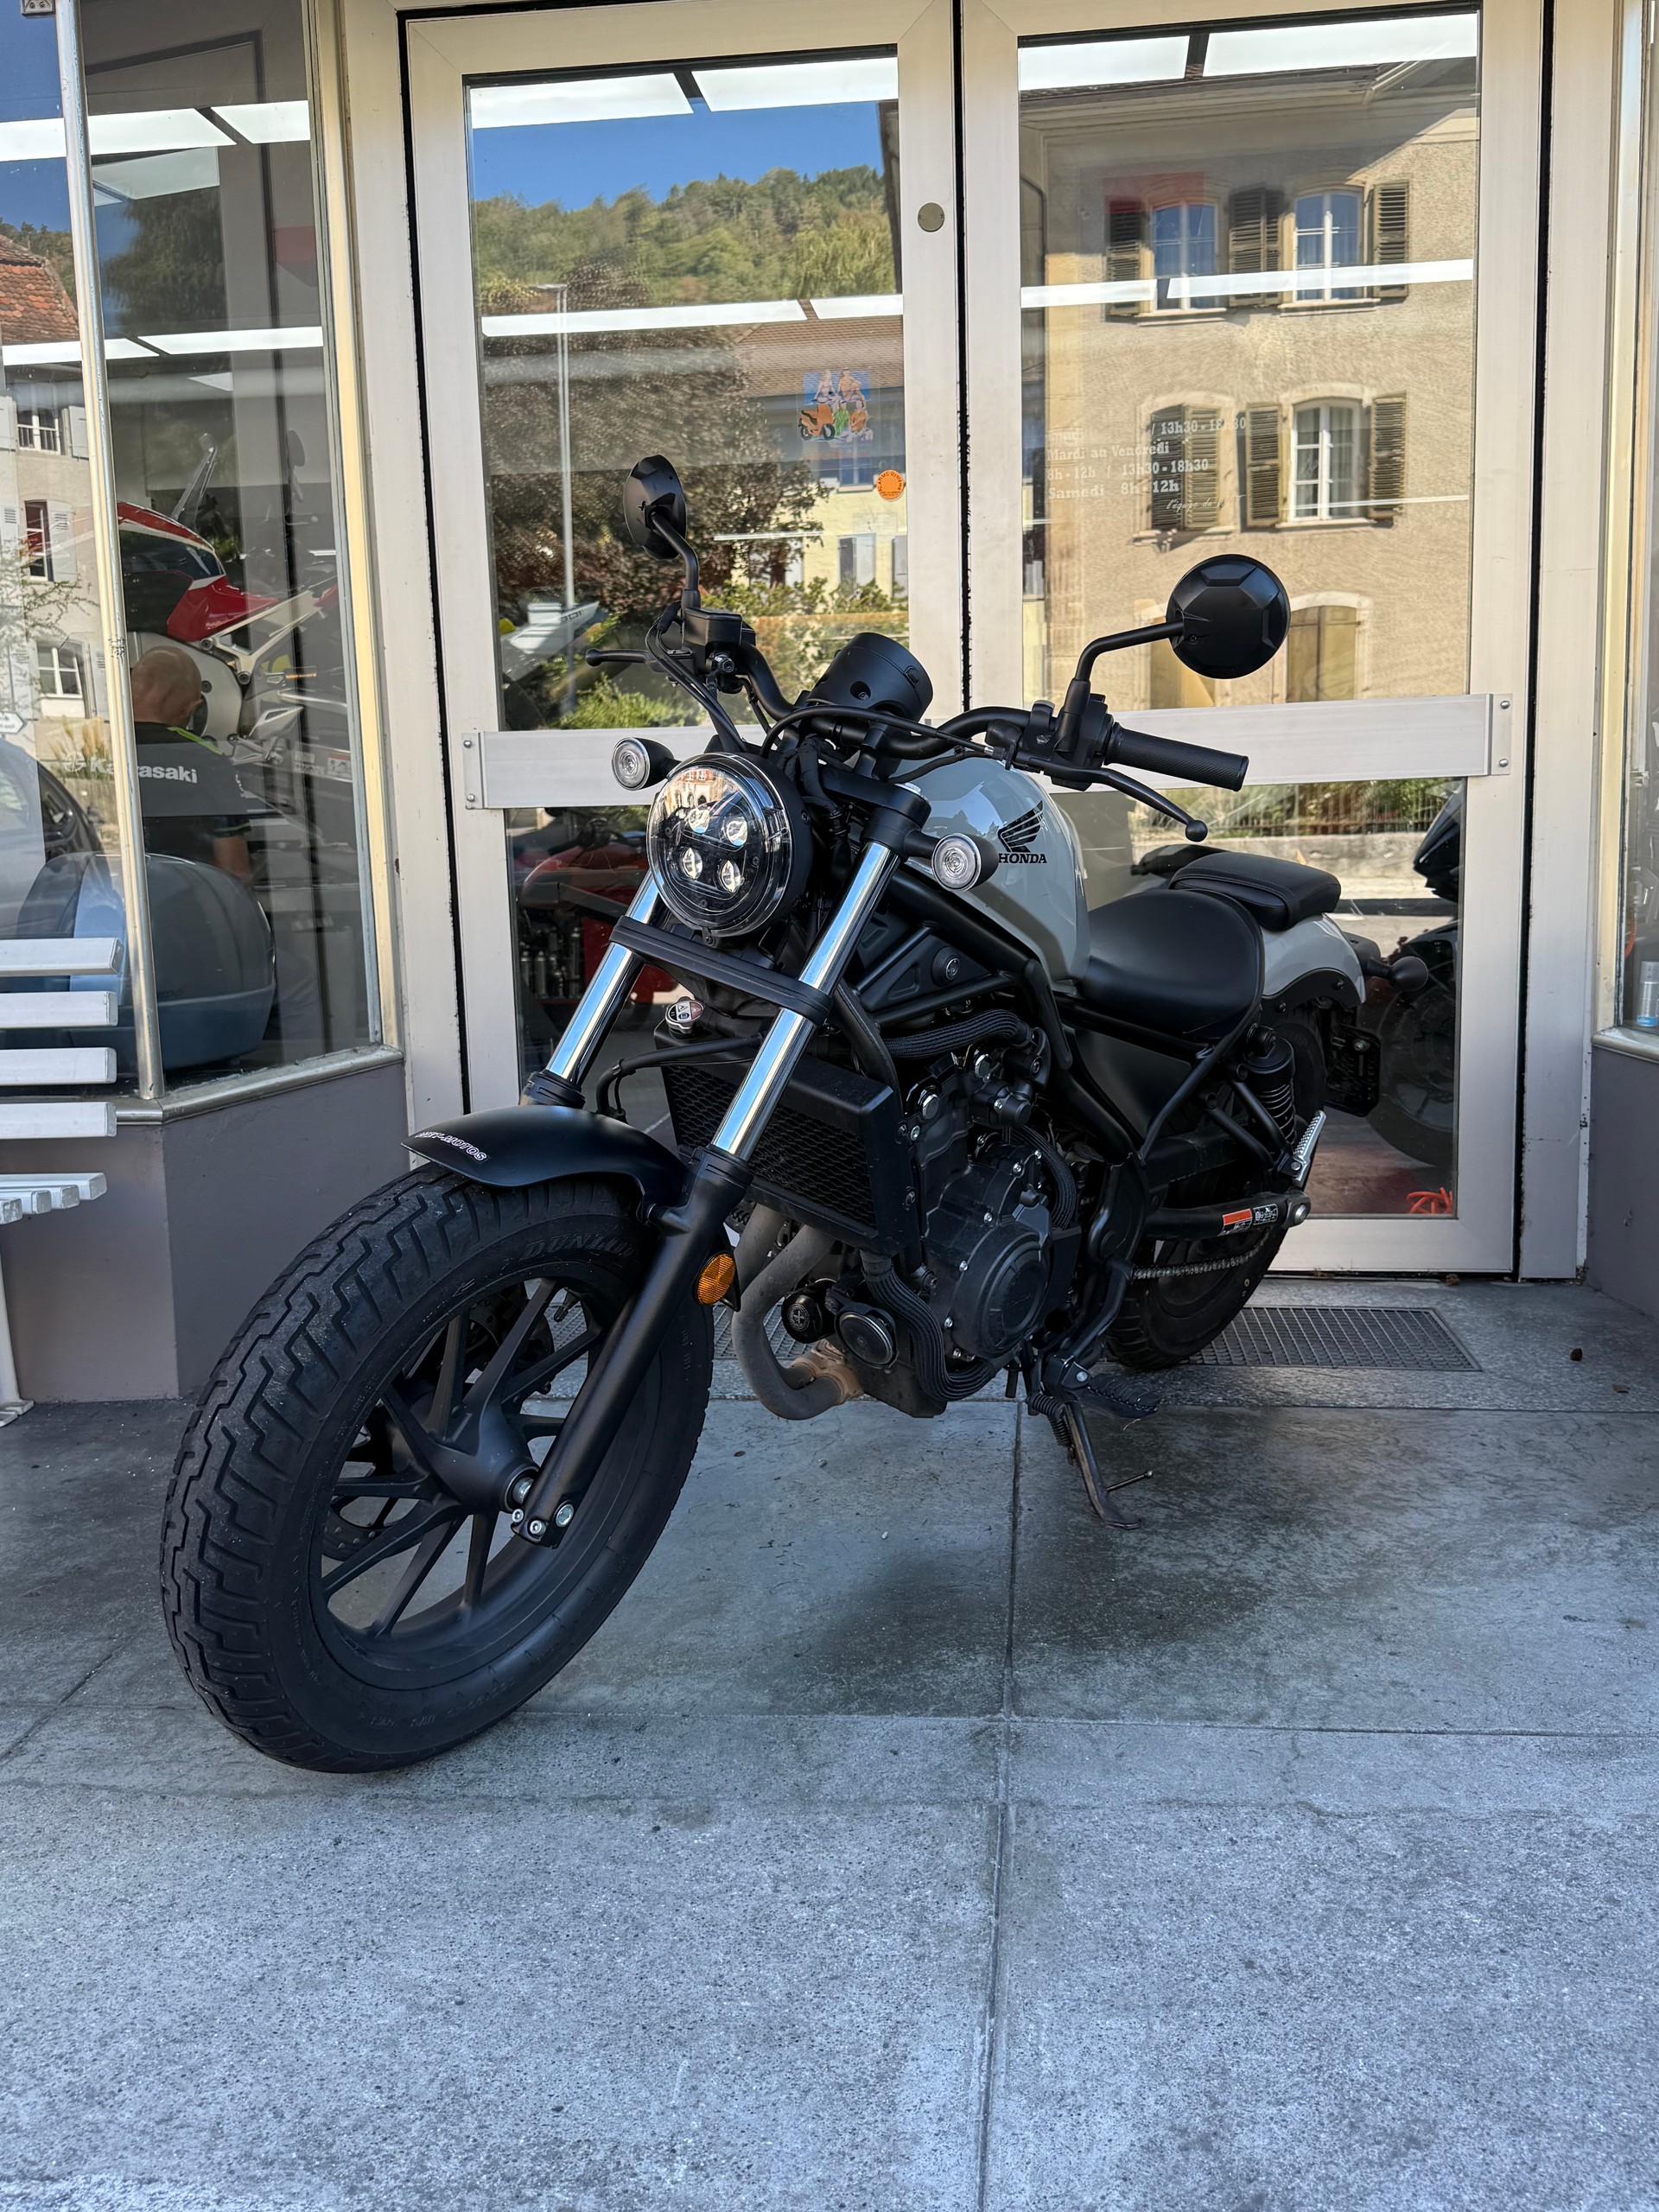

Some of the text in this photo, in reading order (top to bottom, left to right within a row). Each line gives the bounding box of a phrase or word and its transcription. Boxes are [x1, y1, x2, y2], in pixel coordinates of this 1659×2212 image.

[1160, 419, 1198, 435] 13h30
[1209, 416, 1246, 432] 1830
[1047, 442, 1169, 461] Mardi au Vendredi
[1074, 466, 1096, 480] 12h
[1122, 461, 1160, 477] 13h30
[1171, 458, 1210, 474] 18h30
[1048, 484, 1105, 499] Samedi
[1121, 481, 1139, 495] 8h
[1153, 480, 1179, 493] 12h
[999, 853, 1048, 864] HONDA
